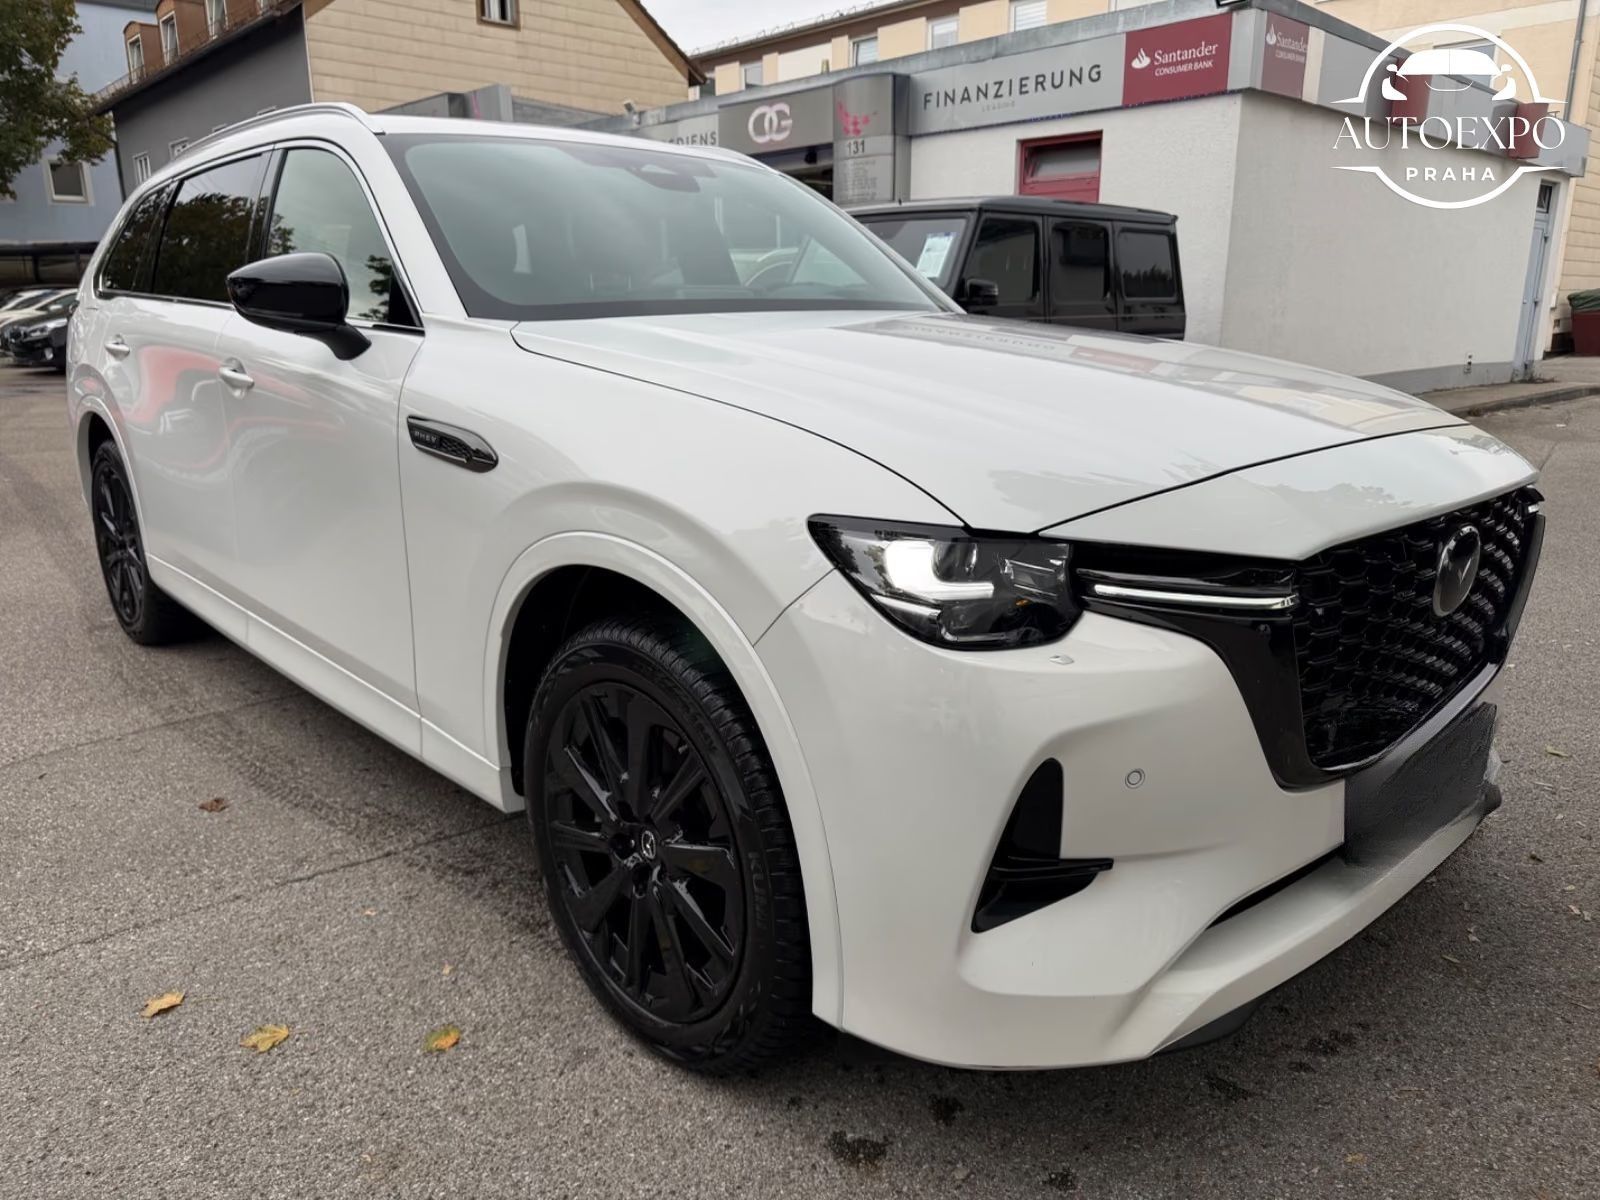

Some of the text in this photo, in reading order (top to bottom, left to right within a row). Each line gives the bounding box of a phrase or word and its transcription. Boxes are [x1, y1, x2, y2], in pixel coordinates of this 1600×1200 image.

[1153, 40, 1219, 65] Santander
[1276, 31, 1307, 52] Santande
[1154, 59, 1214, 77] CONSUMER BANK
[923, 64, 1102, 111] FINANZIERUNG
